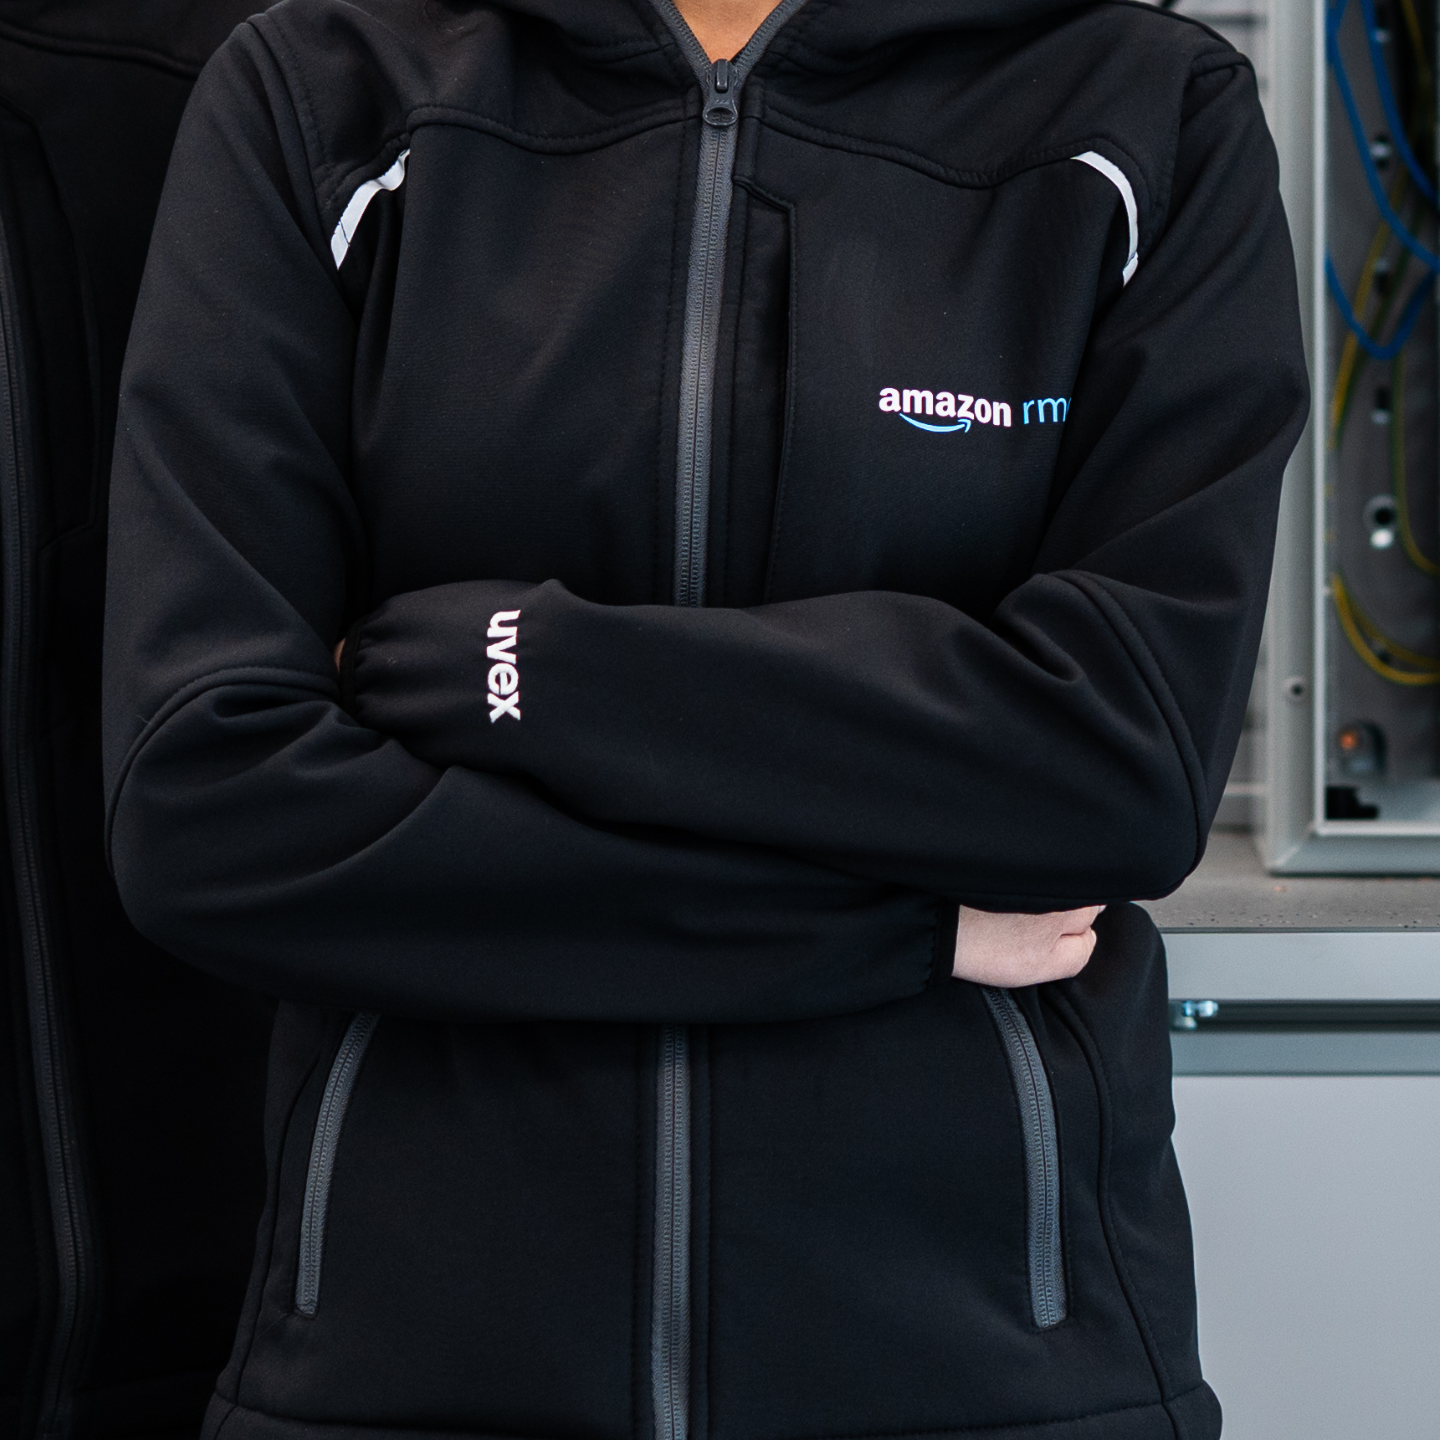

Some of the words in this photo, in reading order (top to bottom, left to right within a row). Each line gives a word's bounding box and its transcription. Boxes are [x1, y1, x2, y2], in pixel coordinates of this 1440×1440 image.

[878, 387, 1012, 427] amazon
[1022, 396, 1071, 425] rm
[486, 609, 522, 724] uvex
